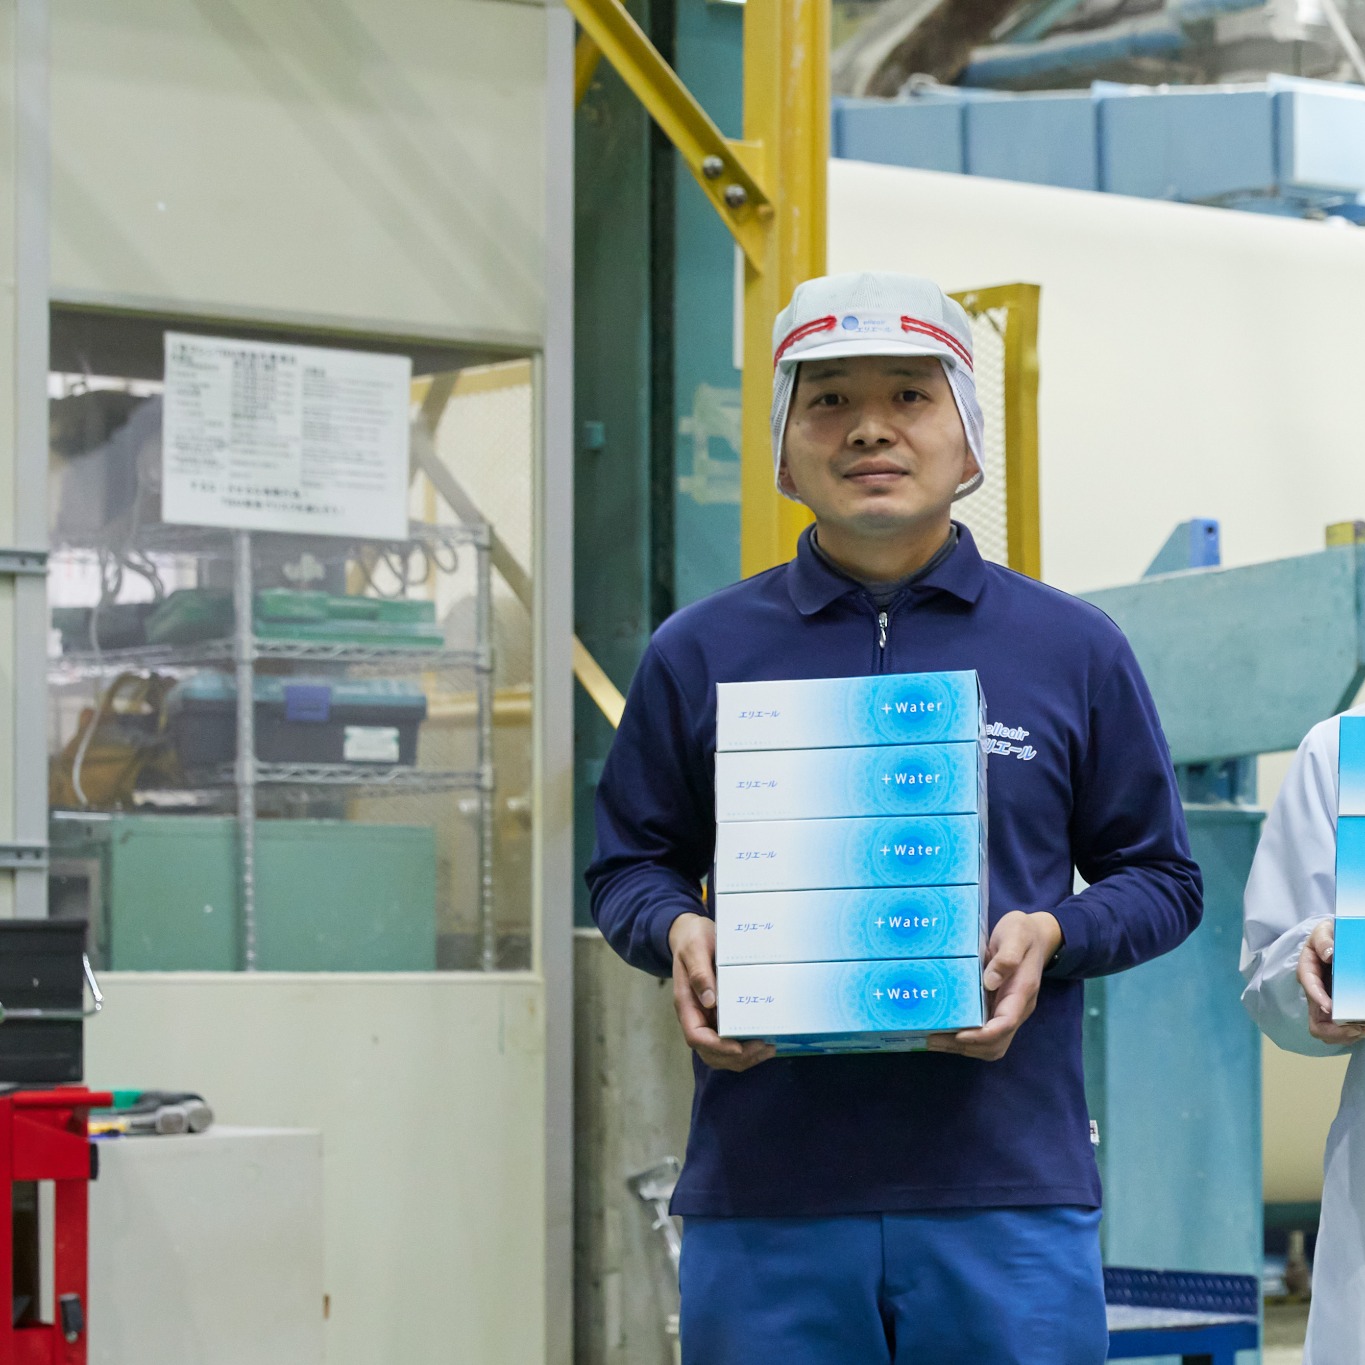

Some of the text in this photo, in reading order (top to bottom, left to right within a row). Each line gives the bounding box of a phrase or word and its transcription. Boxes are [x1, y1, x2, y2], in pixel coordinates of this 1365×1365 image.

[738, 710, 780, 719] エリエール
[986, 722, 1029, 741] elleair
[986, 738, 1037, 760] リエール
[736, 779, 778, 790] エリエール
[735, 850, 777, 860] エリエール
[735, 921, 773, 932] エリエール
[736, 994, 774, 1004] エリエール
